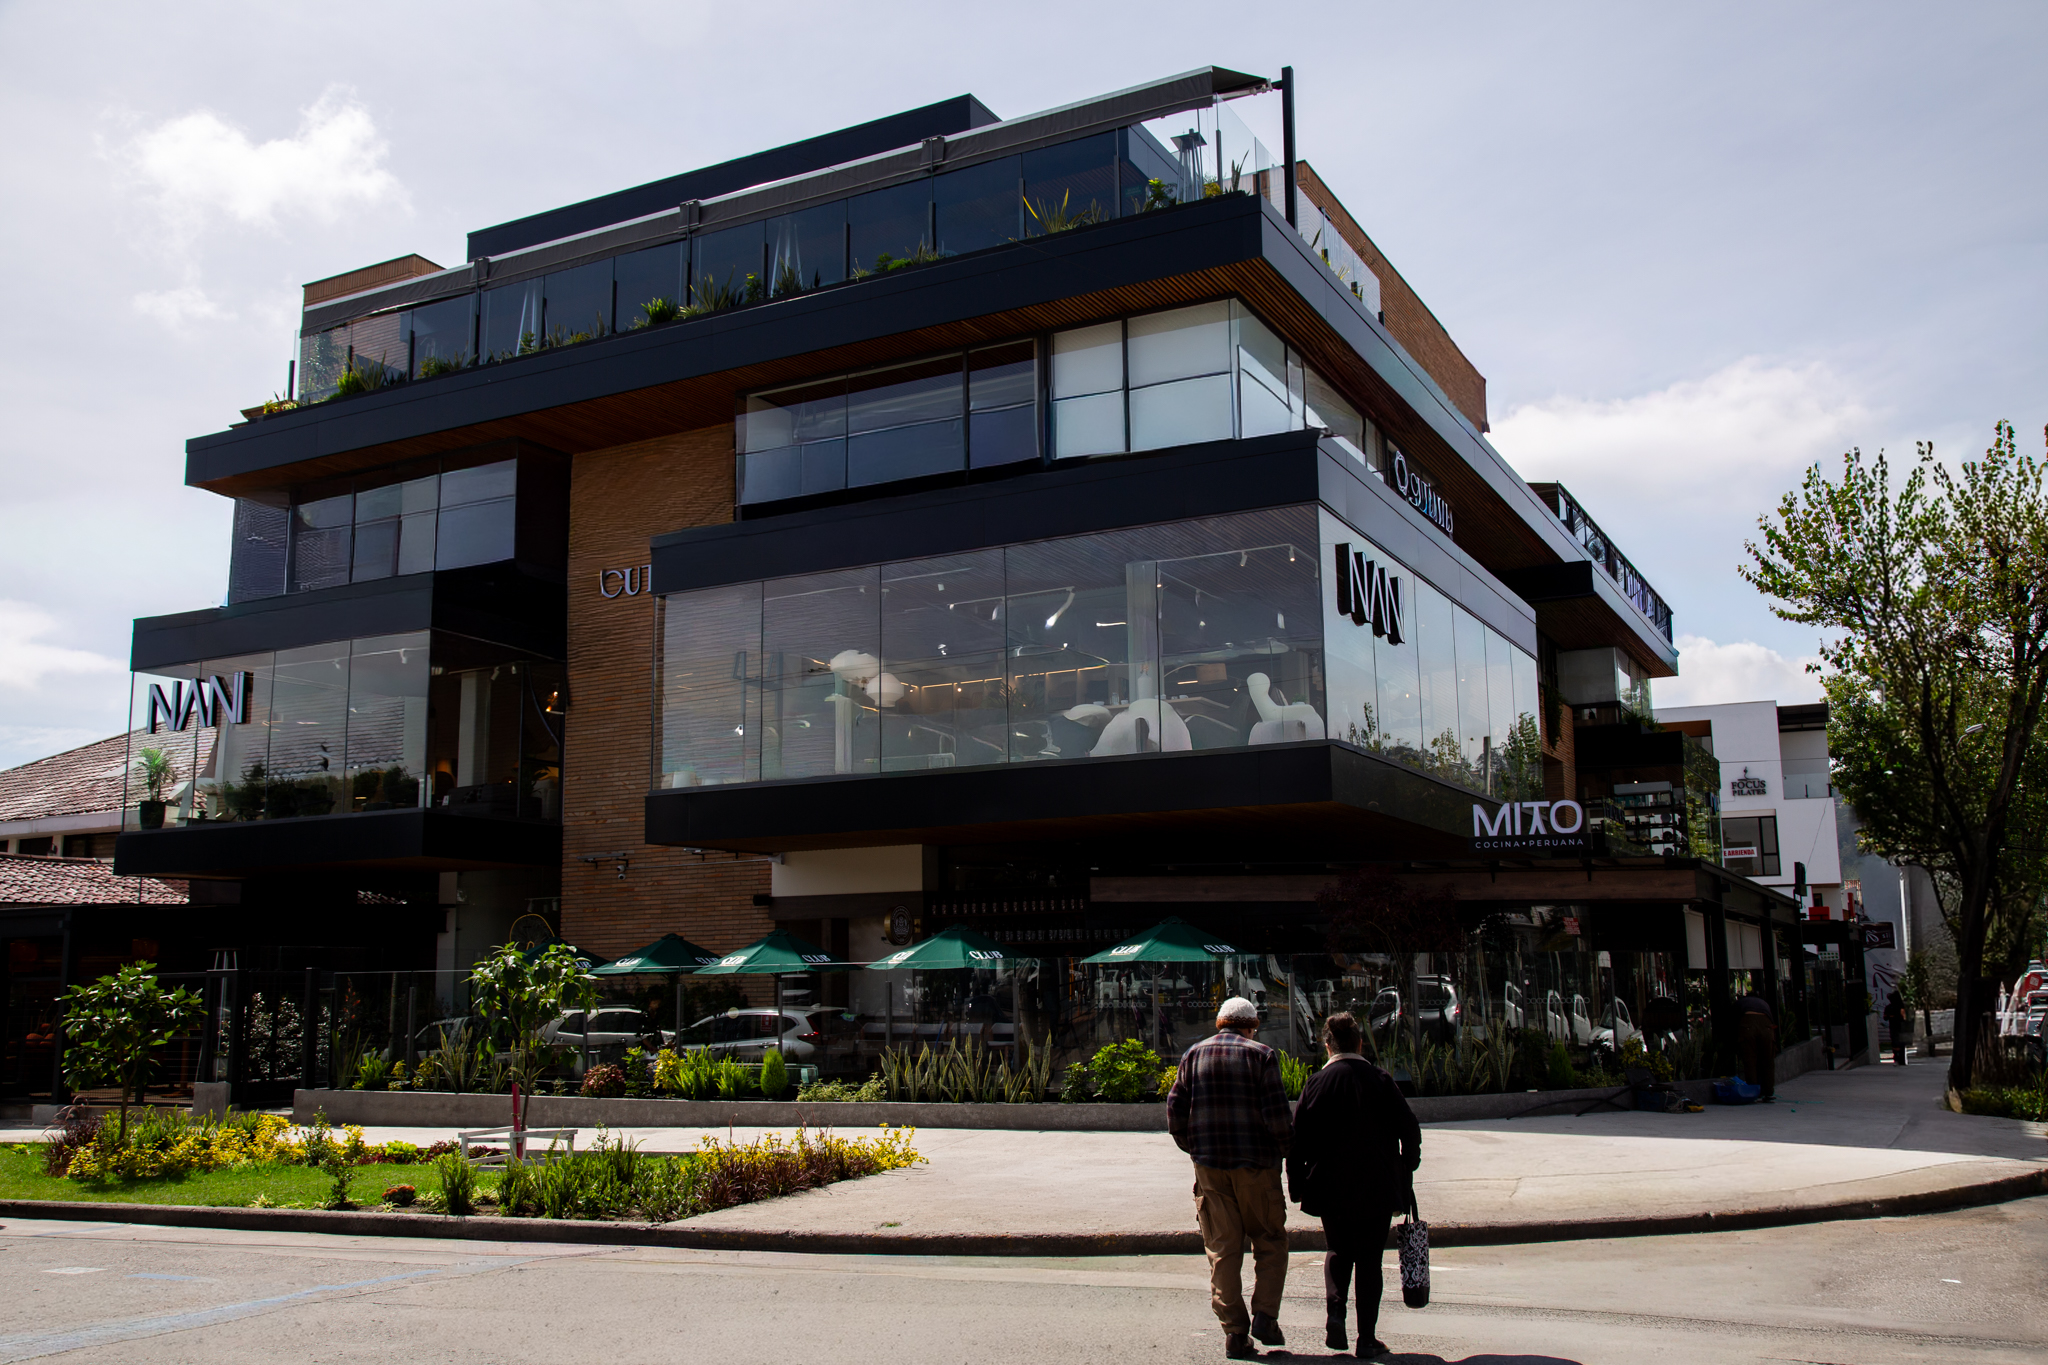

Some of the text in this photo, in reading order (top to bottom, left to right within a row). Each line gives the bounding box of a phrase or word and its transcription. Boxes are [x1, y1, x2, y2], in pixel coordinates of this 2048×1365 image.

[1731, 780, 1767, 790] FOCUS
[1732, 788, 1767, 797] PILATES
[1472, 799, 1584, 837] MITO
[1475, 839, 1584, 849] COCINA PERUANA
[1727, 848, 1755, 857] ARRIENDA
[1112, 945, 1143, 954] CLUB
[1204, 944, 1236, 953] CLUB
[801, 954, 832, 963] CLUB
[969, 950, 1004, 960] CLUB
